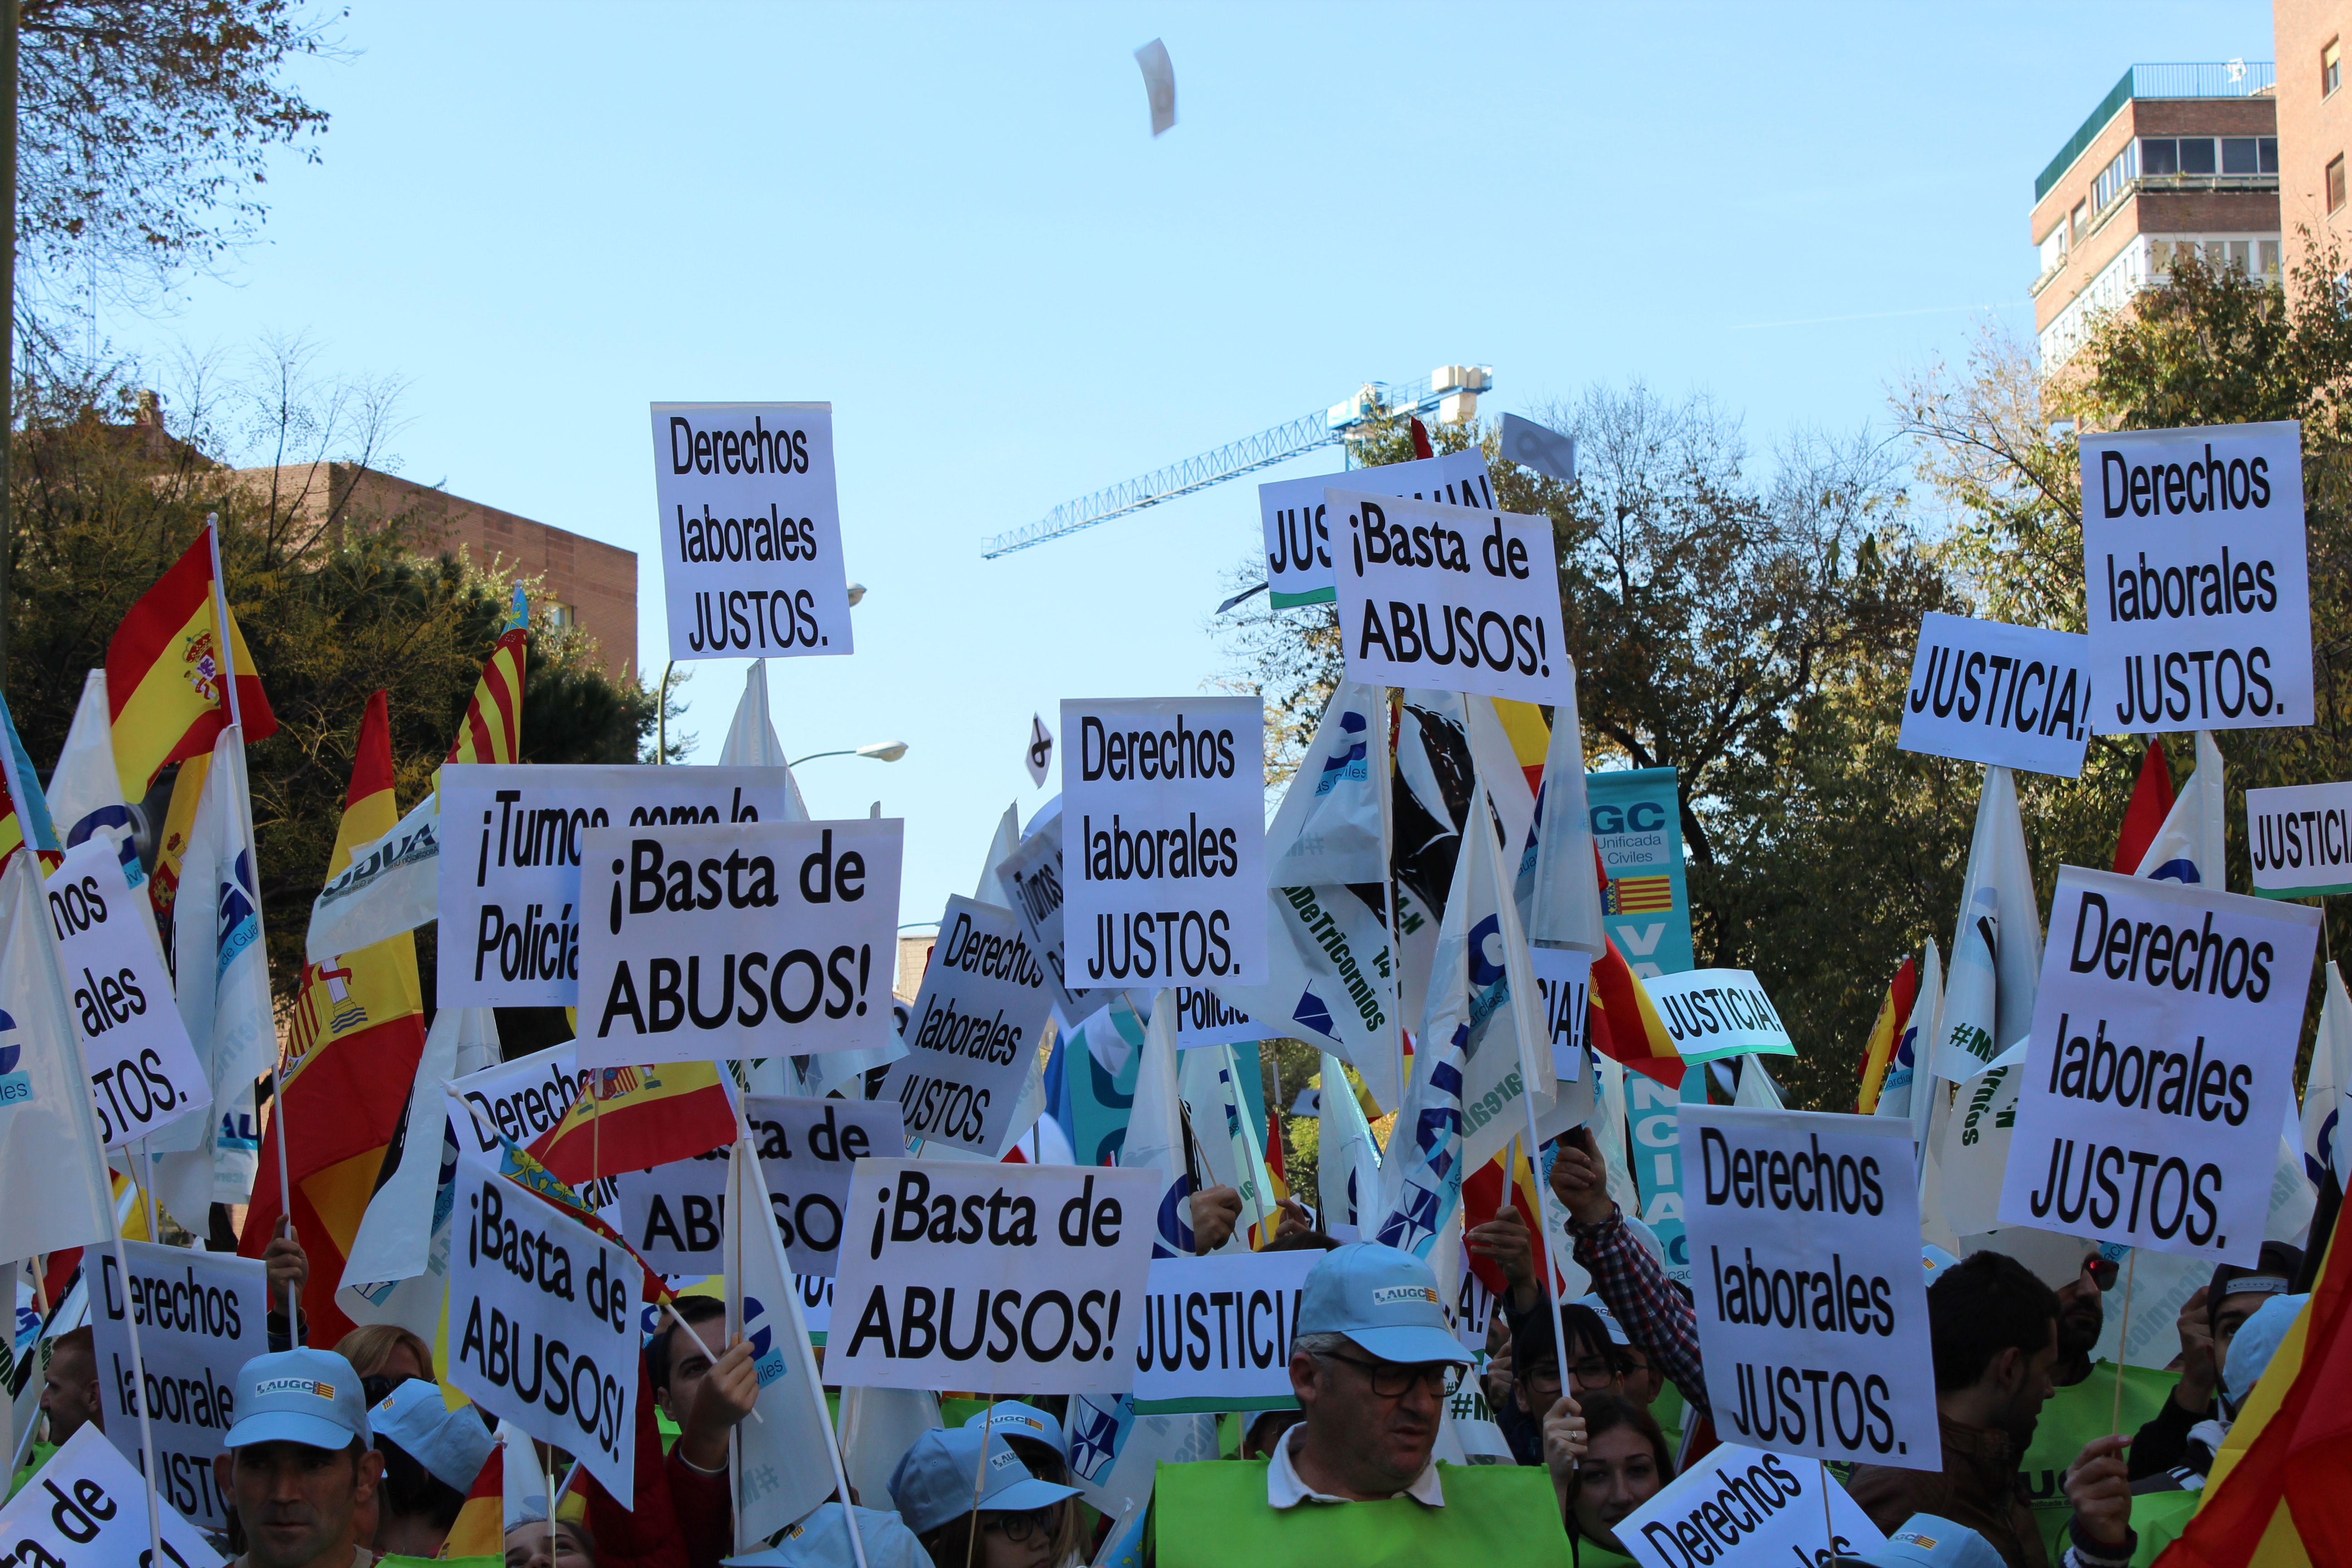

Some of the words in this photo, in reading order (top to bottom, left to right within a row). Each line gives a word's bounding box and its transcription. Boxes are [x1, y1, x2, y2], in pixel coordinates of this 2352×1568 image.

[670, 416, 809, 475] Derechos
[2102, 444, 2270, 518] Derechos
[677, 504, 817, 563] laborales
[1349, 502, 1470, 578] ¡Basta
[1483, 517, 1529, 579] de
[689, 589, 828, 652] JUSTOS.
[2107, 546, 2277, 621] laborales
[1359, 599, 1550, 677] ABUSOS!
[1911, 646, 2091, 741] JUSTICIA!
[2117, 647, 2284, 725] JUSTOS.
[1082, 714, 1235, 781] Derechos
[477, 790, 609, 887] ¡Turno
[1084, 812, 1238, 881] laborales
[1596, 834, 1661, 849] Unificada
[1608, 852, 1653, 864] Civiles
[2253, 809, 2352, 871] JUSTICI
[610, 839, 779, 935] ¡Basta
[799, 829, 865, 903] de
[222, 948, 234, 965] de
[1088, 910, 1240, 979] JUSTOS.
[2070, 891, 2274, 1003] Derechos
[598, 944, 870, 1038] ABUSOS!
[915, 993, 1022, 1066] laborales
[1662, 988, 1782, 1041] JUSTICIA!
[2049, 1013, 2252, 1126] laborales
[808, 1106, 870, 1162] de
[1700, 1127, 1883, 1216] Derechos
[870, 1171, 1038, 1260] ¡Basta
[1058, 1175, 1122, 1247] de
[2031, 1138, 2226, 1249] JUSTOS.
[469, 1181, 575, 1302] ¡Basta
[586, 1247, 627, 1334] de
[1711, 1245, 1894, 1337] laborales
[102, 1255, 241, 1340] Derechos
[846, 1285, 1121, 1362] ABUSOS!
[113, 1352, 233, 1430] laborale
[460, 1296, 624, 1464] ABUSOS!
[1732, 1362, 1907, 1455] JUSTOS.
[42, 1478, 118, 1544] de
[1640, 1453, 1802, 1568] Derechos
